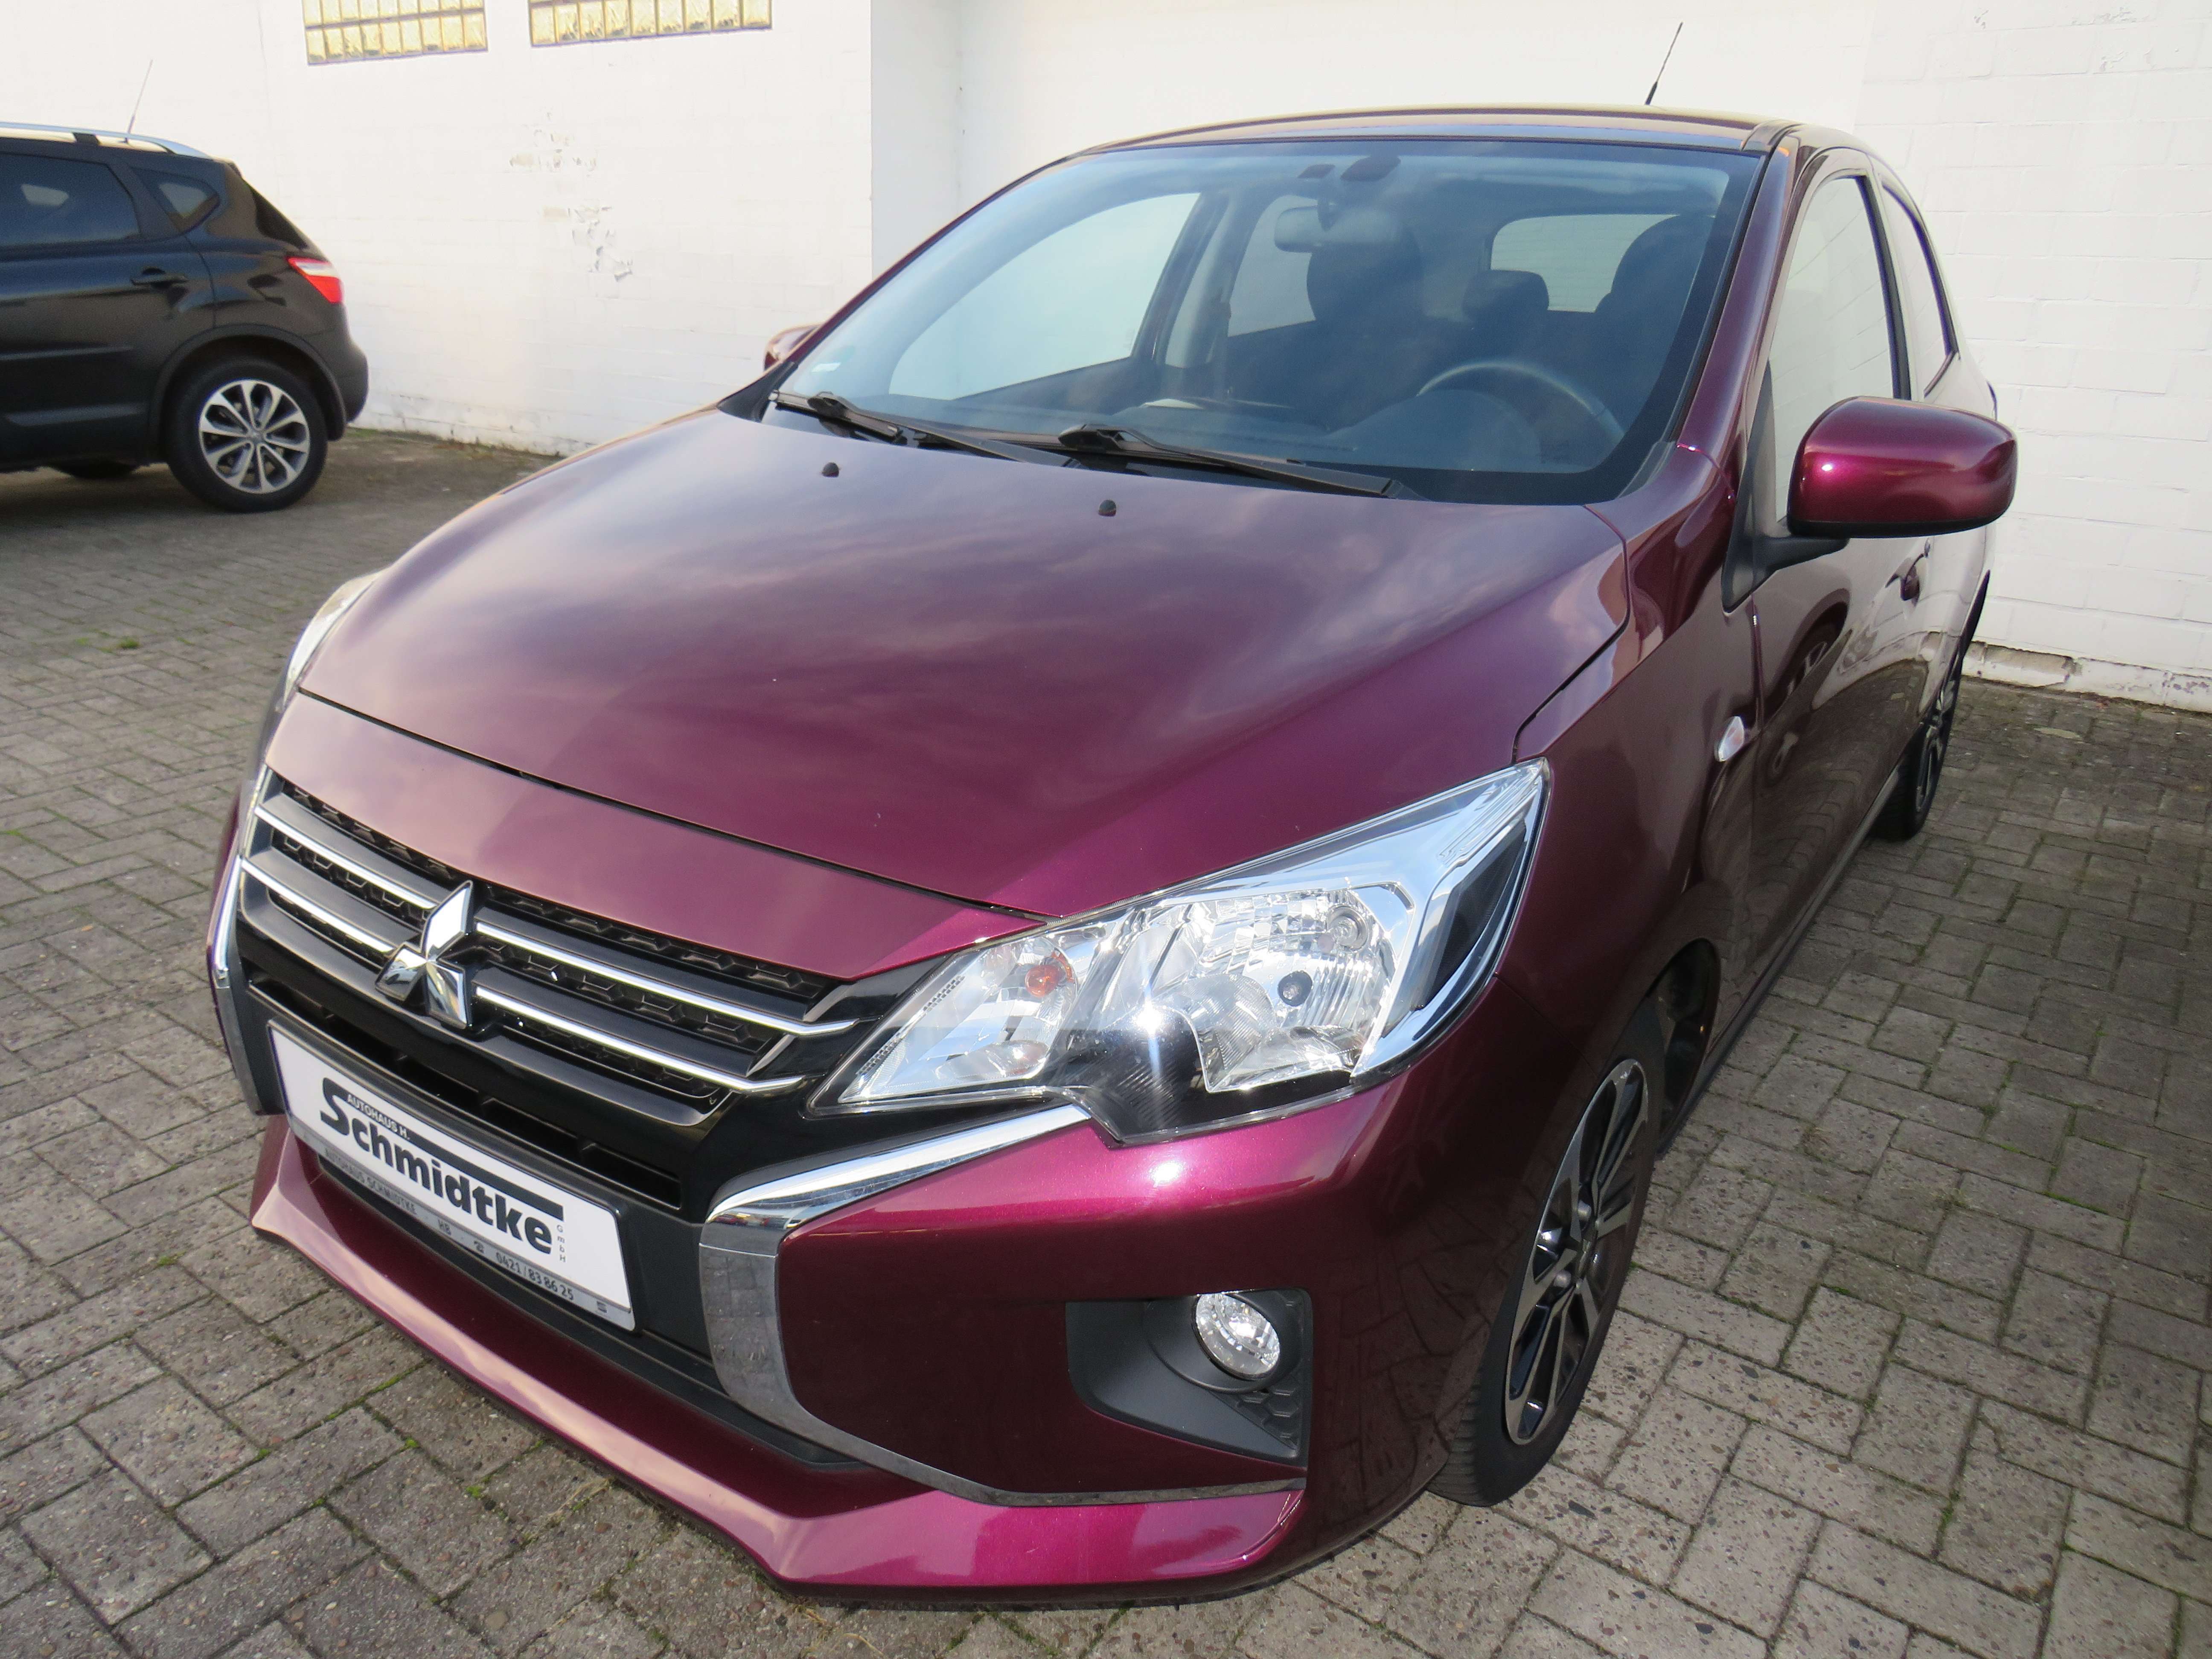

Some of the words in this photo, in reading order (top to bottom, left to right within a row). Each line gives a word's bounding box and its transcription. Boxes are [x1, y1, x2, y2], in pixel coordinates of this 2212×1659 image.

[320, 1077, 552, 1254] Schmidtke
[347, 1094, 398, 1132] AUTOHAUS
[399, 1125, 410, 1140] H.
